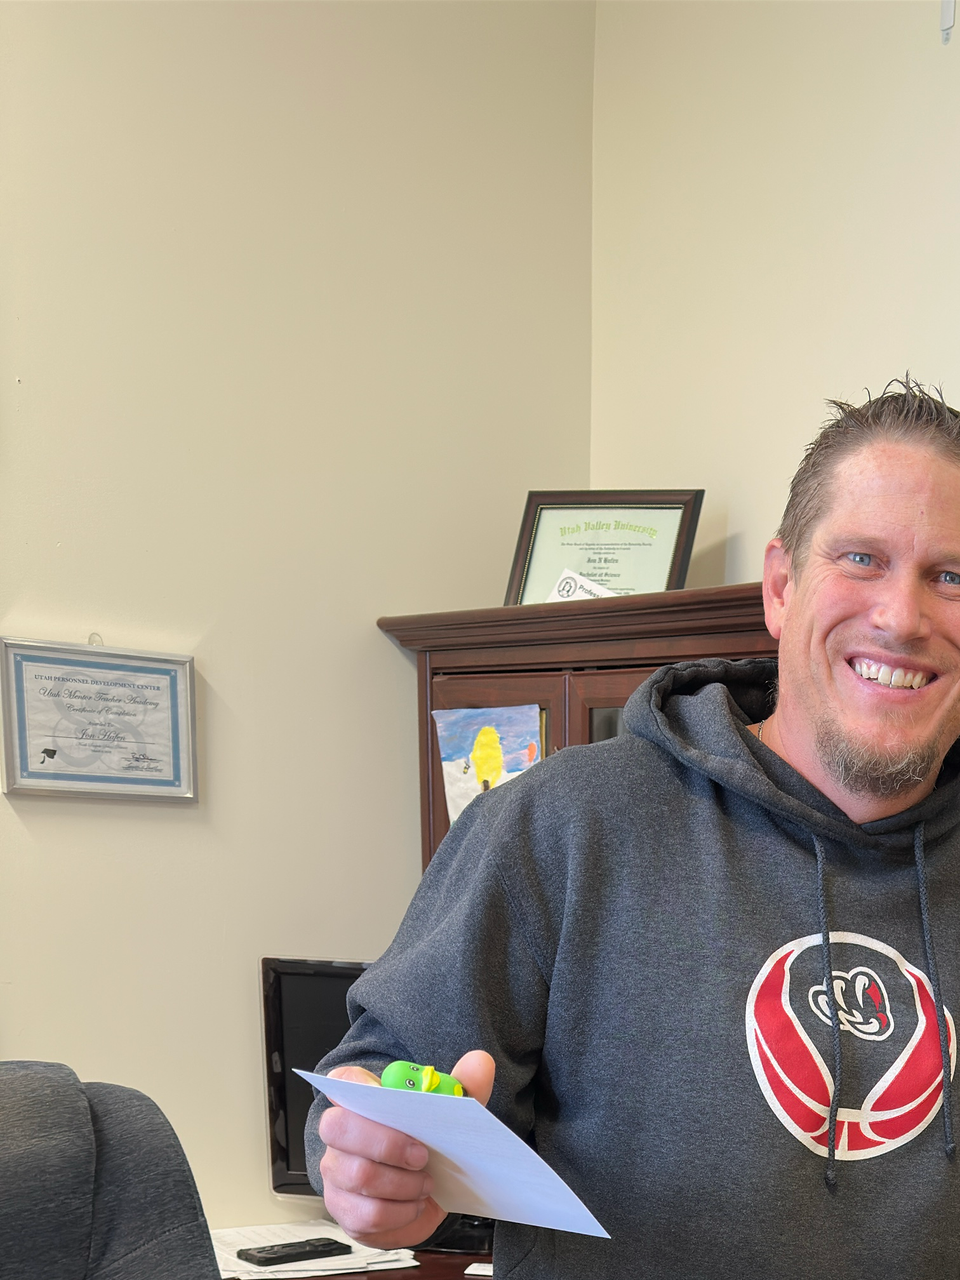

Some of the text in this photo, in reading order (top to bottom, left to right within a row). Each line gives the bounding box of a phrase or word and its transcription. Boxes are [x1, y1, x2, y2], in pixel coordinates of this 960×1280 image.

[584, 521, 611, 532] Valley
[613, 520, 658, 539] University
[54, 676, 89, 685] PERSONNEL
[91, 679, 136, 689] DEVELOPMENT
[39, 686, 160, 709] Utah Mentor Teacher Academy
[66, 703, 137, 717] Certificate of Completion
